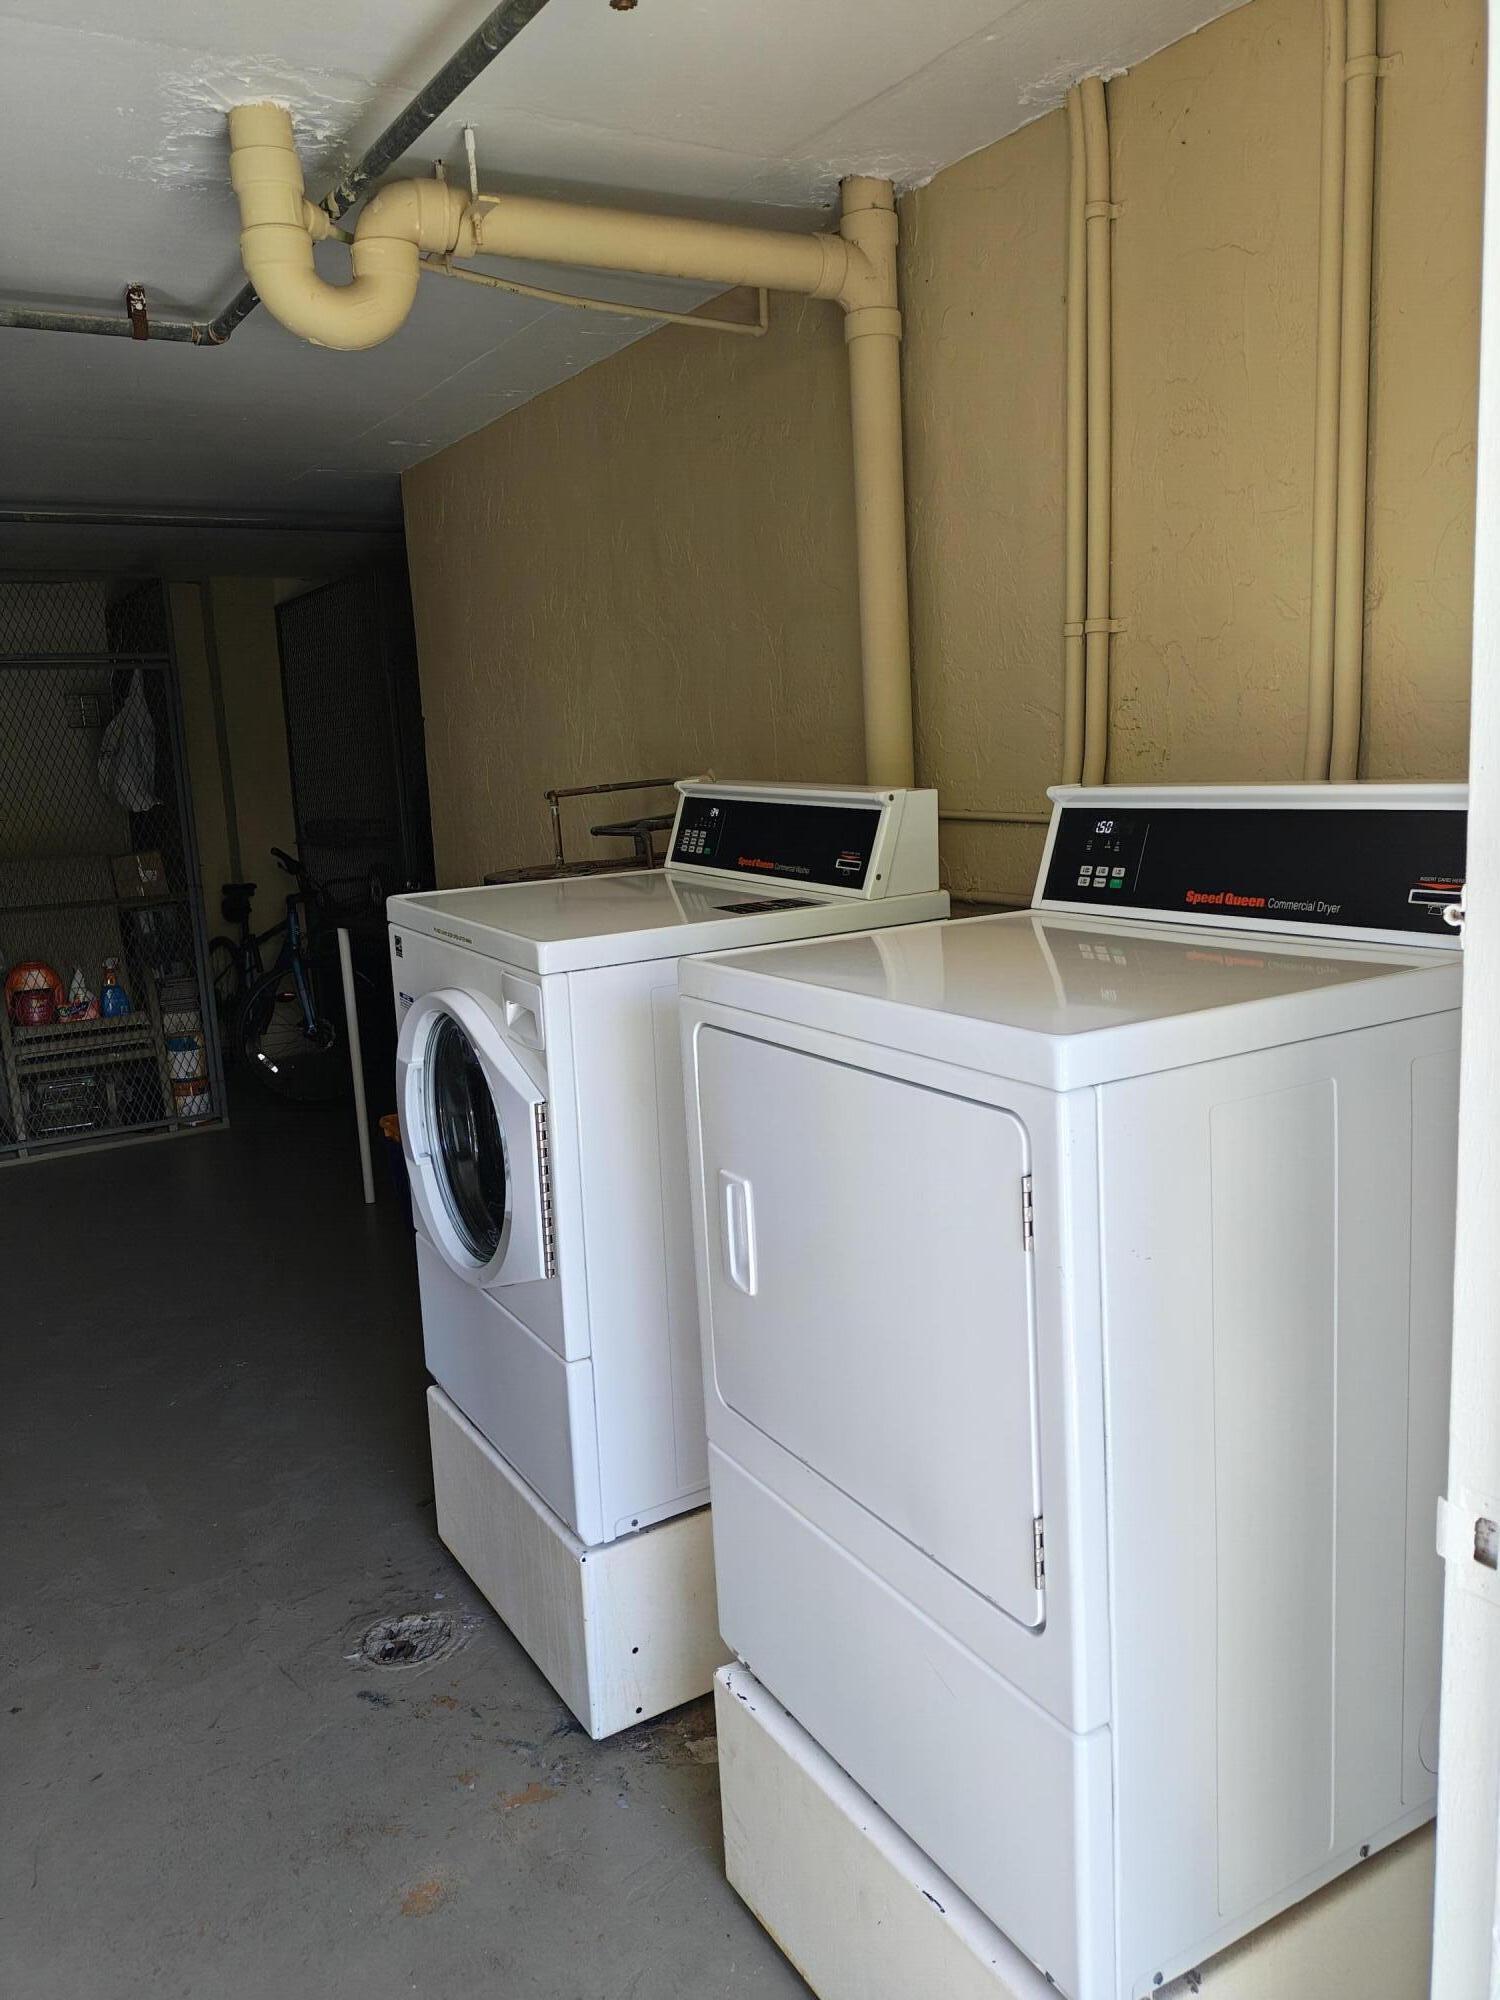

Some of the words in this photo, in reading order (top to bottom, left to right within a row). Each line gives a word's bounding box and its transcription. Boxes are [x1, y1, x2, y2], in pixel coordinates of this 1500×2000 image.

[1186, 890, 1224, 905] Speed
[1224, 893, 1265, 908] Queen
[1267, 898, 1316, 912] Commercial
[1317, 901, 1342, 916] Dryer
